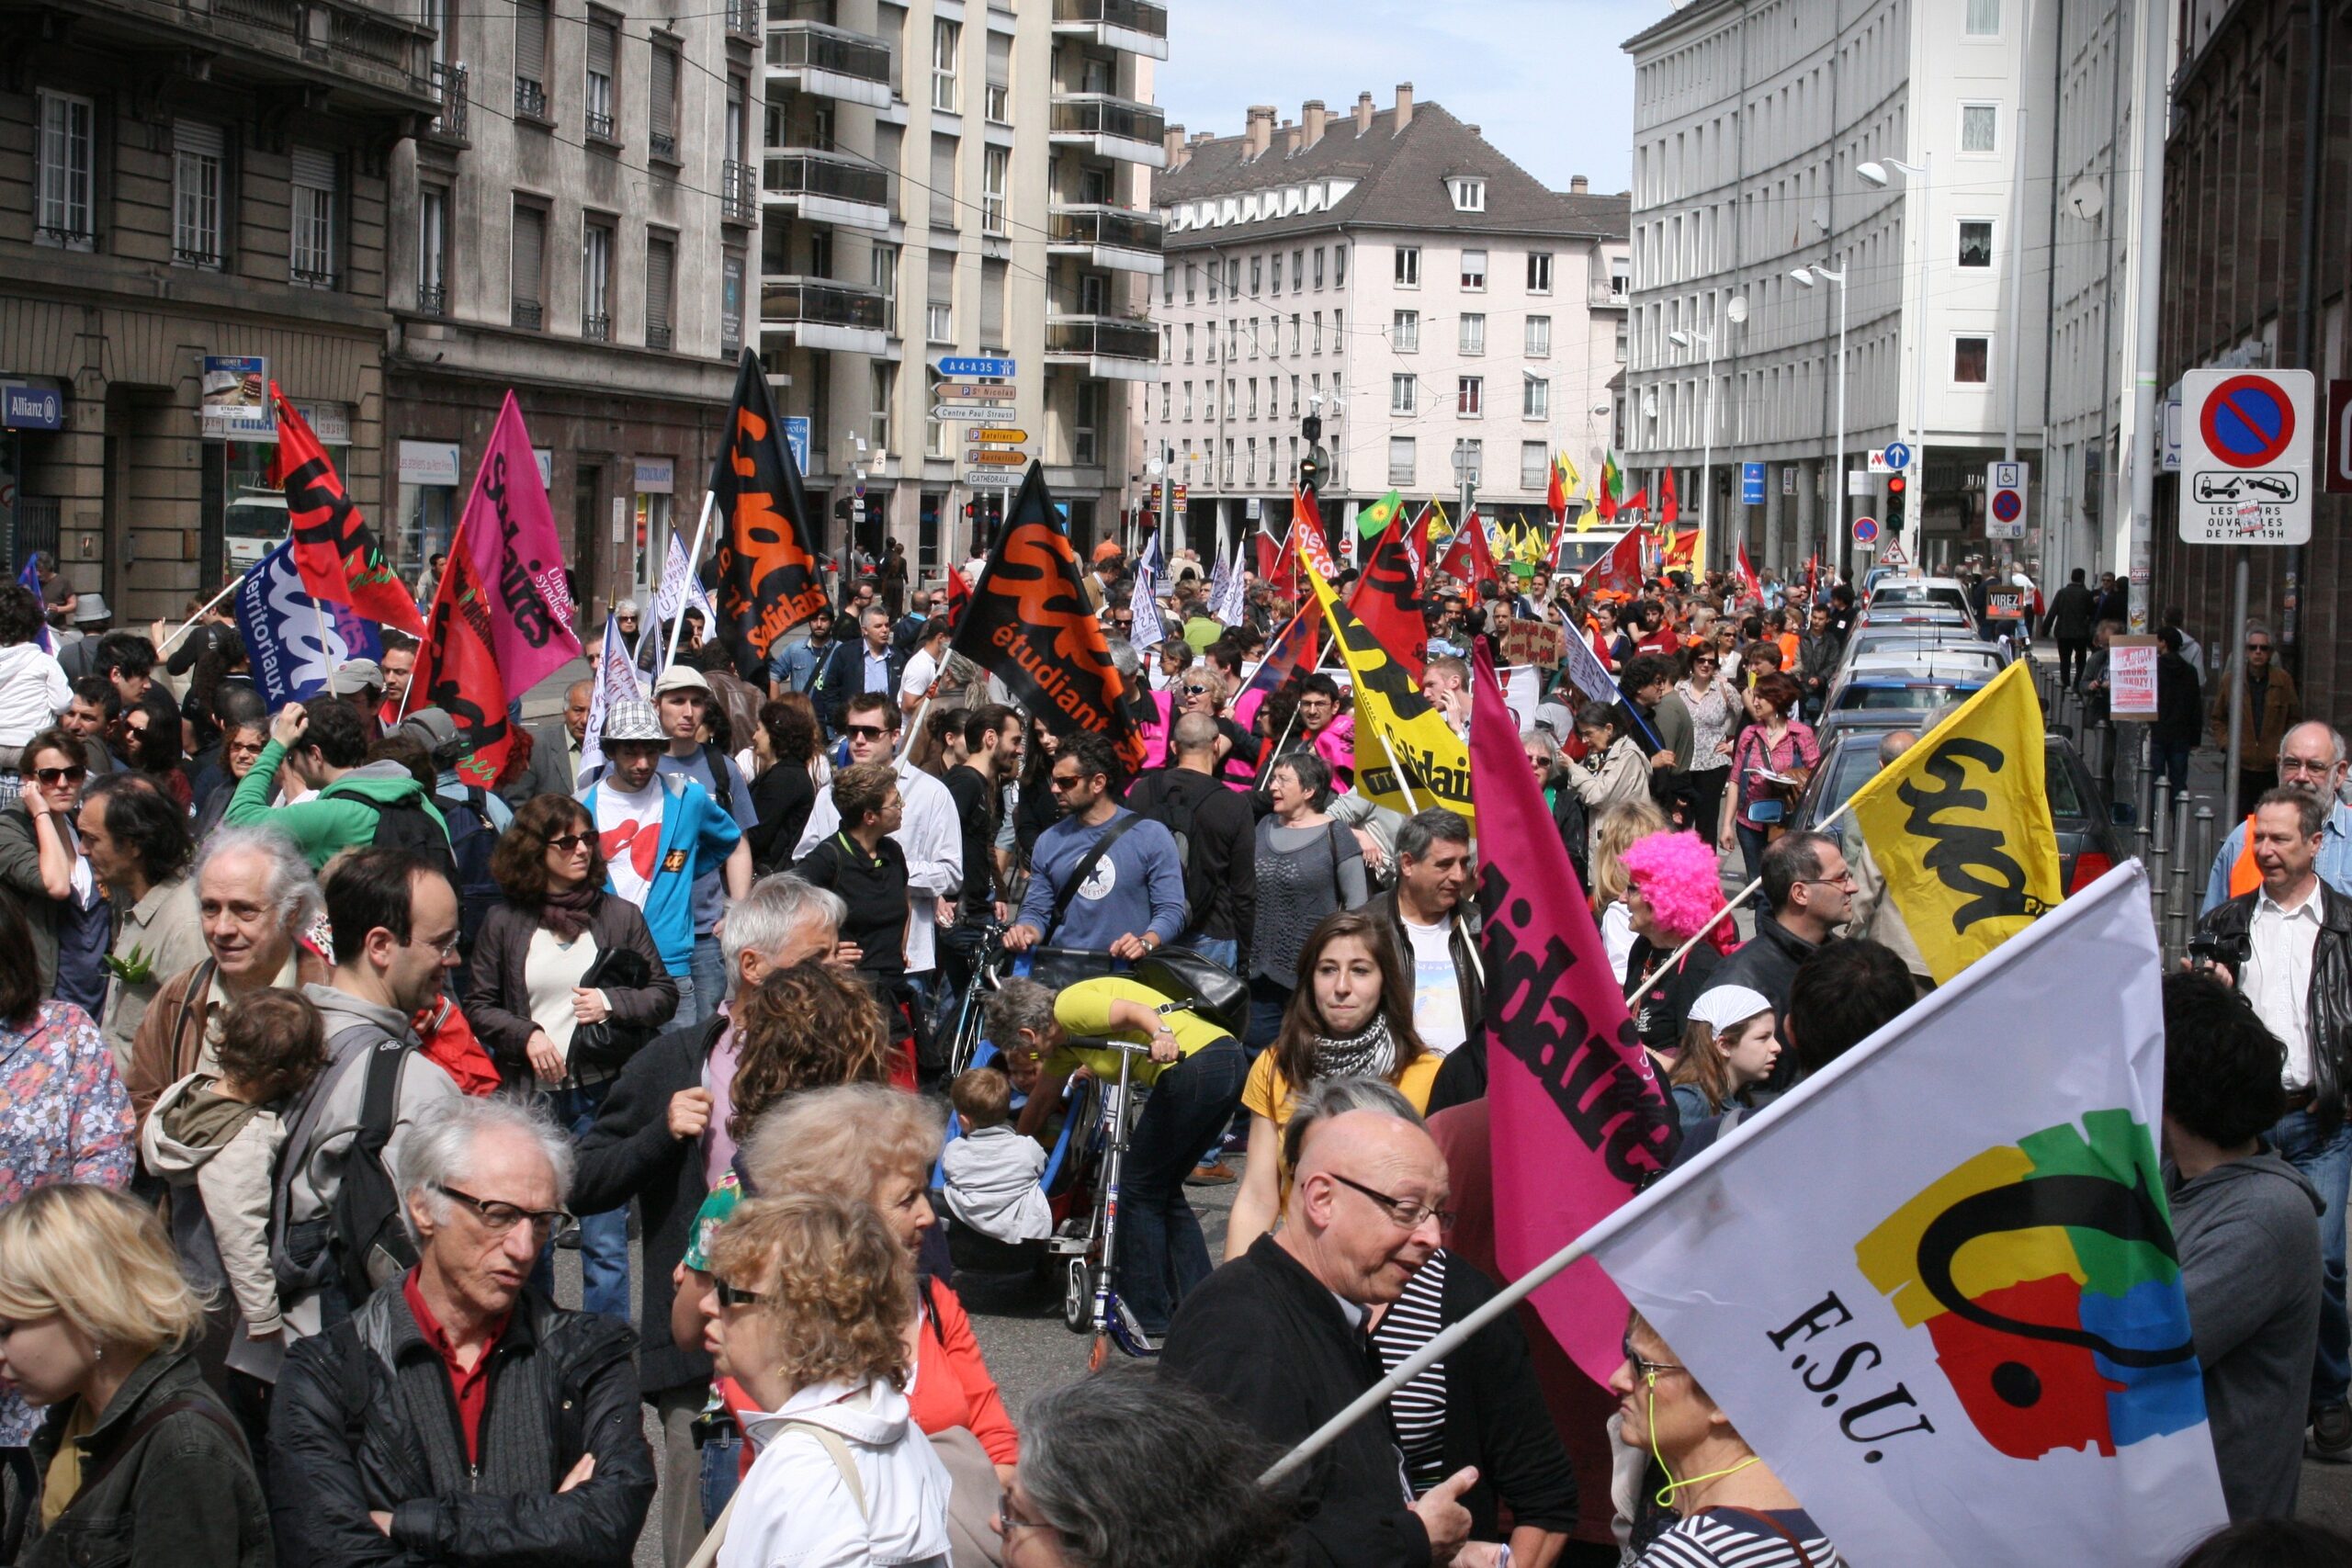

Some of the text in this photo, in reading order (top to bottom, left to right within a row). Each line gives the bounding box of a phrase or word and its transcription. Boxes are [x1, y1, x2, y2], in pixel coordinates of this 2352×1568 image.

[984, 388, 1013, 397] Nicolas
[12, 396, 42, 418] Allianz
[942, 409, 1013, 419] Centre Paul Strauss
[981, 432, 1012, 440] Bateliers
[980, 453, 1018, 462] Austerlitz
[2211, 507, 2233, 515] LES
[2208, 518, 2283, 527] OUVRLES
[2206, 529, 2222, 538] DE
[2228, 529, 2243, 538] 7H
[2262, 529, 2284, 538] 19H
[245, 565, 285, 702] Territoriaux
[991, 621, 1111, 734] étudiant
[1766, 1290, 1936, 1464] F.S.U.
